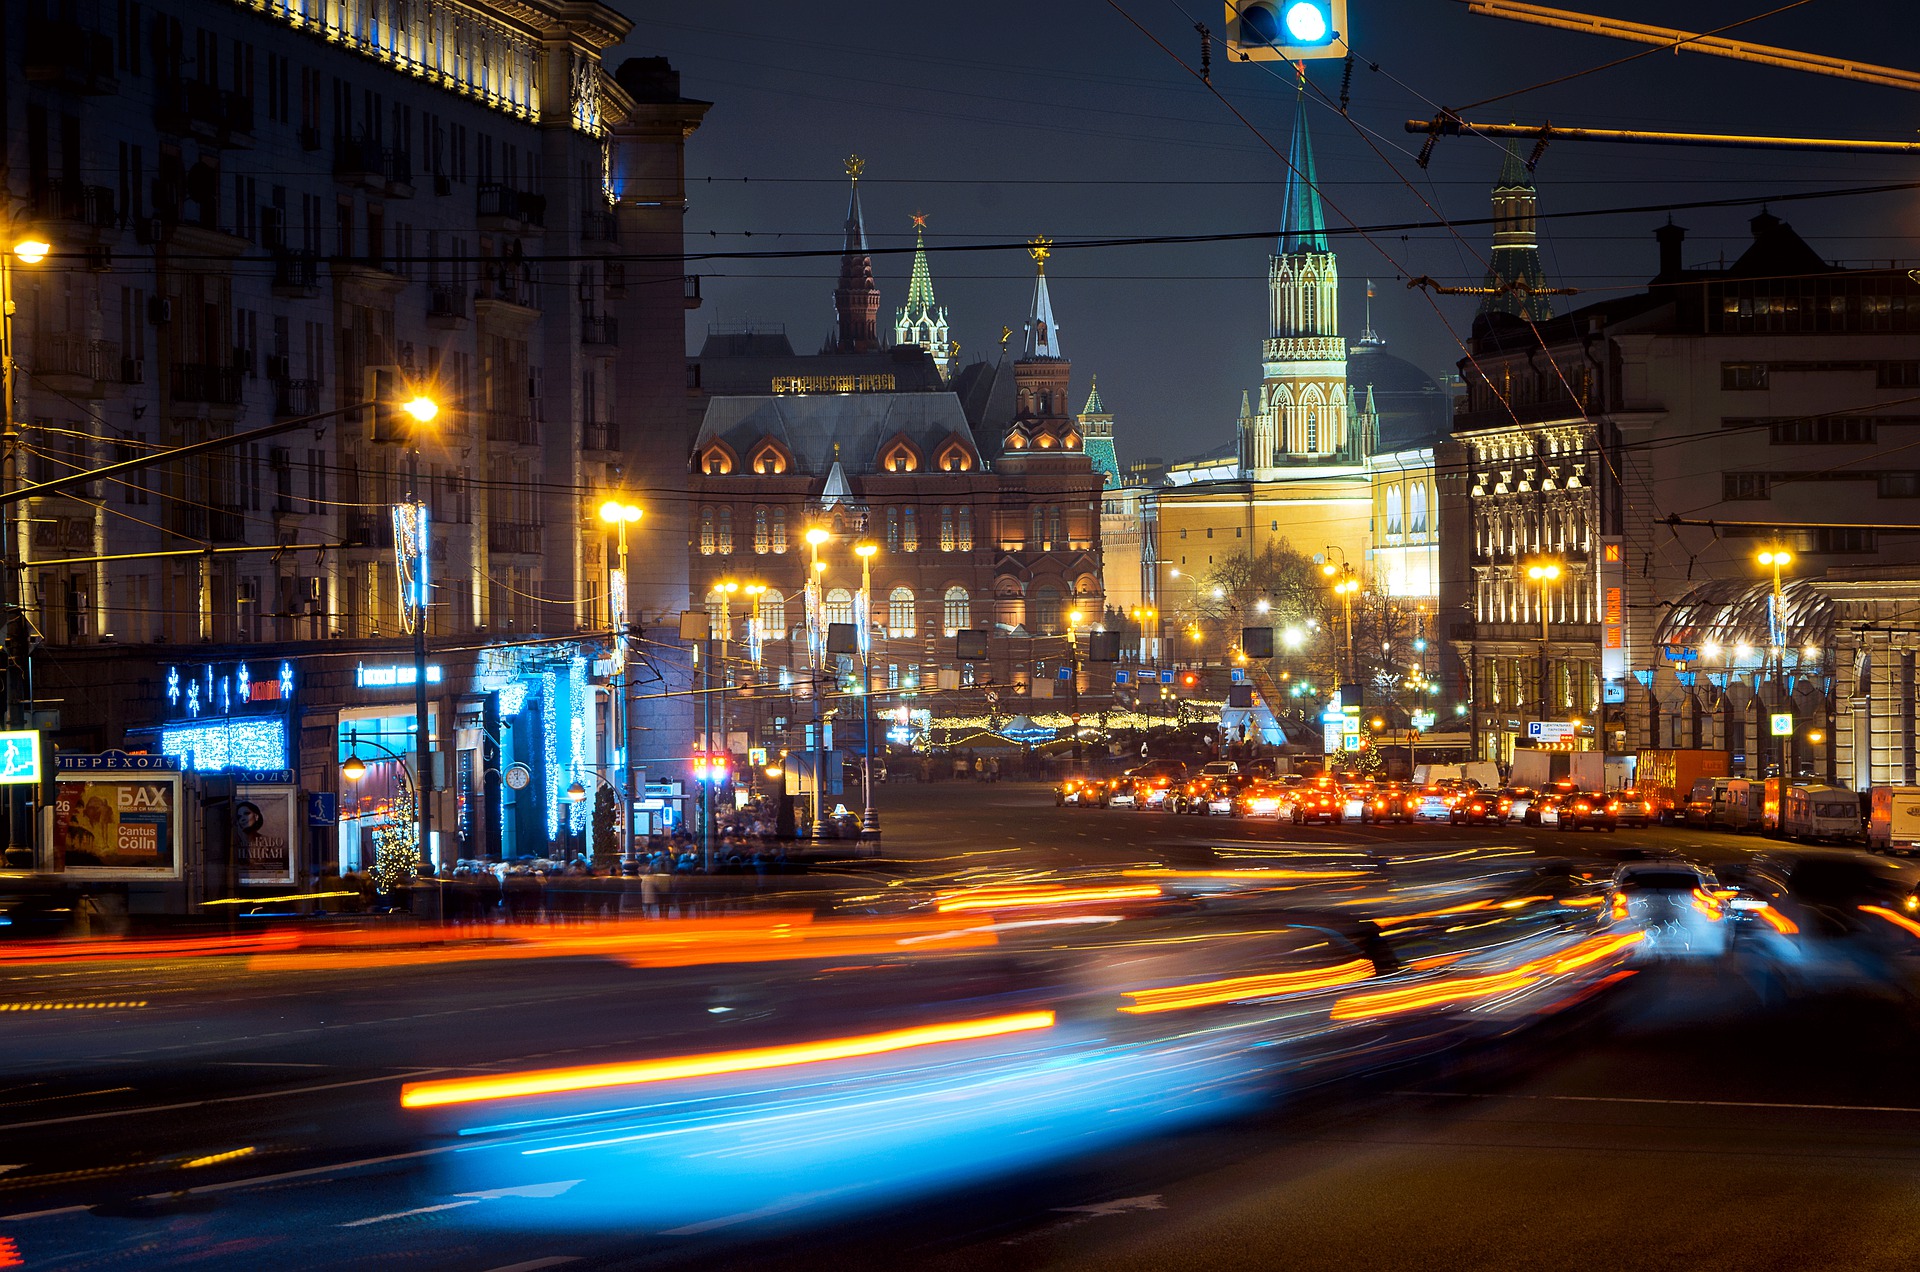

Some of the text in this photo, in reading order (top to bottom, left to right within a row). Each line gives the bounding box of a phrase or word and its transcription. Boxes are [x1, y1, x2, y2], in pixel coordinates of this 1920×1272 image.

[65, 758, 163, 768] ПЕРЕХОД
[117, 787, 168, 806] БАХ
[55, 800, 71, 812] 26
[118, 826, 156, 836] Cantus
[118, 837, 156, 850] Cölln
